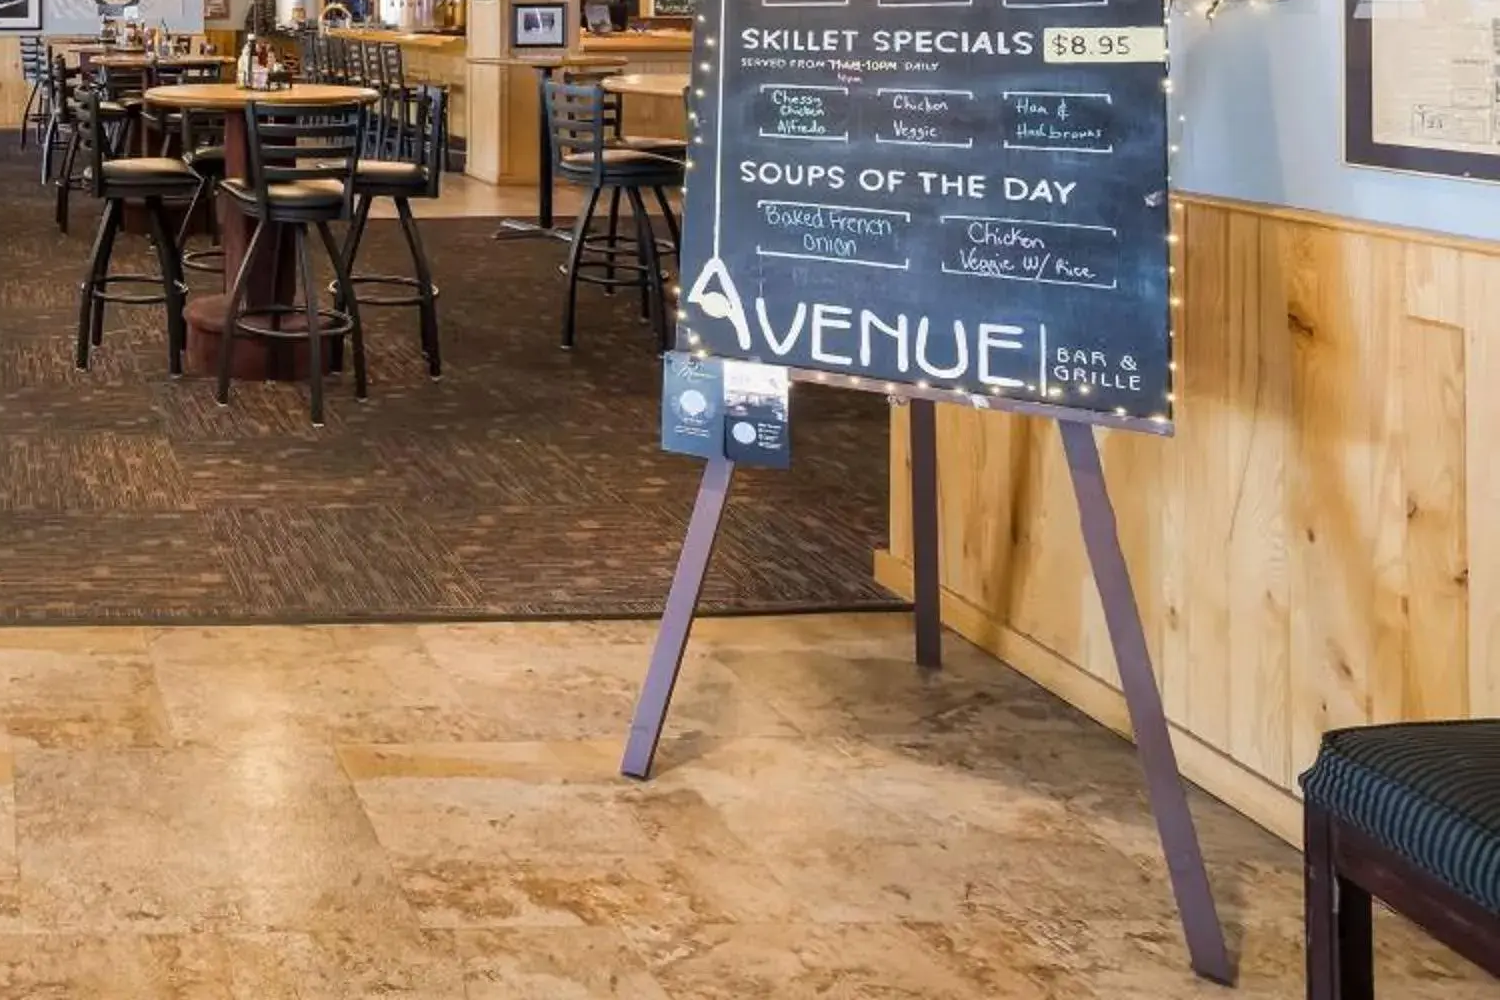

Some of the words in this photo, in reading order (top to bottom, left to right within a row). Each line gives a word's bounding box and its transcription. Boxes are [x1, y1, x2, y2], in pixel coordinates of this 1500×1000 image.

[741, 28, 859, 51] SKILLET
[873, 30, 1035, 55] SPECIALS
[1051, 33, 1131, 56] $8.95
[740, 56, 787, 68] SERVED
[789, 58, 826, 70] FROM
[904, 61, 940, 72] DAILY
[893, 94, 948, 111] Chicken
[1016, 97, 1049, 115] Ham
[777, 119, 827, 134] Alfredo
[893, 119, 939, 140] Veggie
[740, 160, 846, 189] SOUPS
[859, 169, 907, 193] OF
[917, 171, 987, 199] THE
[1003, 176, 1078, 205] DAY
[765, 205, 826, 228] Baked
[829, 211, 893, 236] French
[967, 221, 1045, 250] Chicken
[959, 247, 1015, 277] Veggie
[1055, 257, 1098, 280] Rice
[687, 257, 1027, 388] AVENUE
[1057, 347, 1107, 368] BAR
[1120, 354, 1138, 371] &
[1053, 364, 1141, 391] GRILLE
